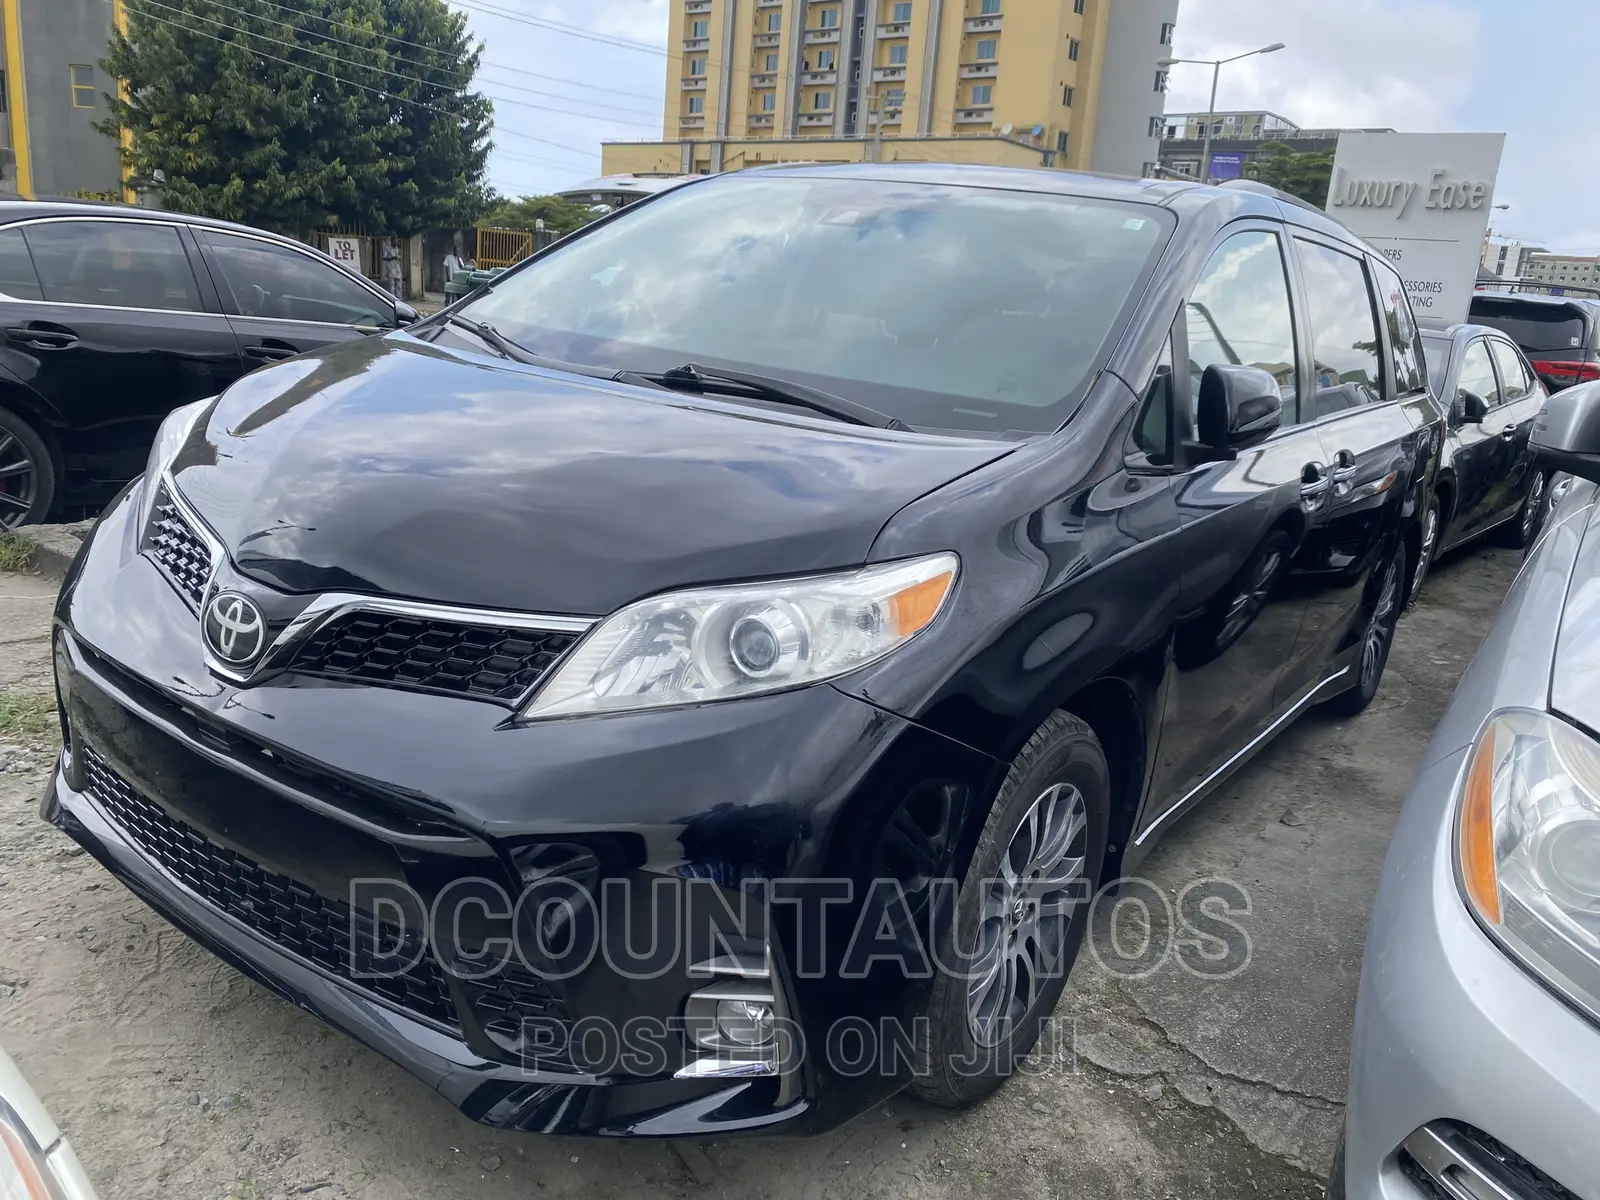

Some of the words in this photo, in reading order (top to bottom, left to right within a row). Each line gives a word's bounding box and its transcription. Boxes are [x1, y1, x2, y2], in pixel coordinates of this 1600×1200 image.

[1333, 167, 1418, 220] Luxury
[1425, 169, 1486, 209] Ease
[336, 240, 351, 250] TO
[334, 249, 355, 260] LET
[1404, 281, 1443, 293] ESSORIES
[1409, 296, 1433, 308] TING
